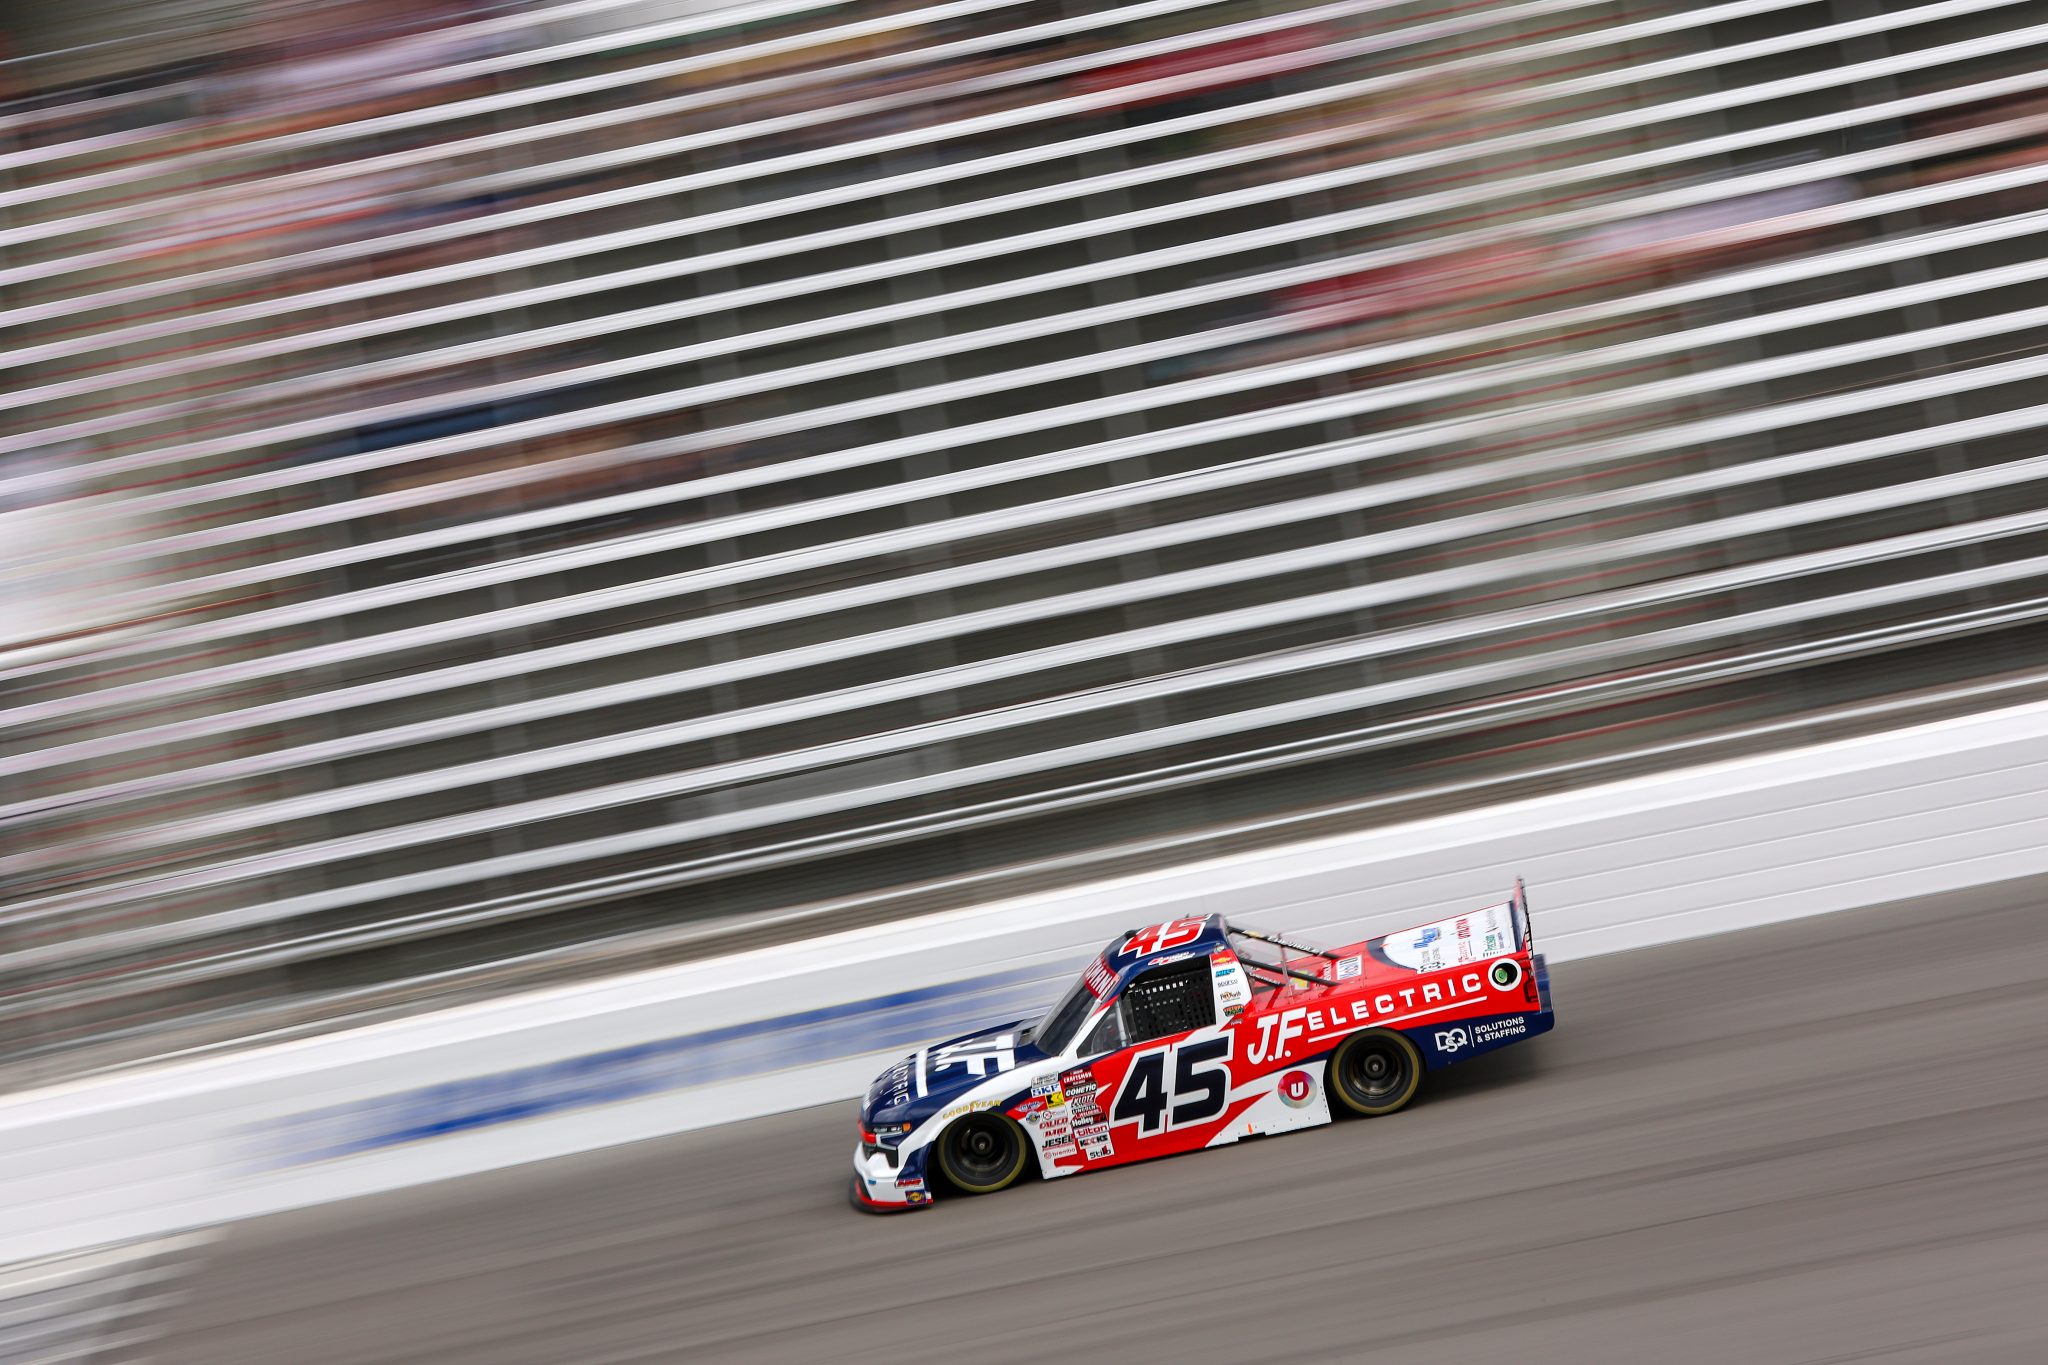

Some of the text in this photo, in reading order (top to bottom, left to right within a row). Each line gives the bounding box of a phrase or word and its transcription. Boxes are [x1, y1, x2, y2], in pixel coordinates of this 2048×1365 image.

[1117, 913, 1213, 959] 45
[1306, 973, 1482, 1031] ELECTRIC
[1248, 1006, 1308, 1065] J.F.
[1475, 1016, 1525, 1035] SOLUTIONS
[1476, 1025, 1526, 1044] & STAFFING
[1032, 1083, 1060, 1097] SKF
[1111, 1032, 1222, 1136] 45
[942, 1099, 1003, 1120] GOODYEAR
[1071, 1115, 1094, 1128] Holley
[1042, 1135, 1073, 1149] JESEL
